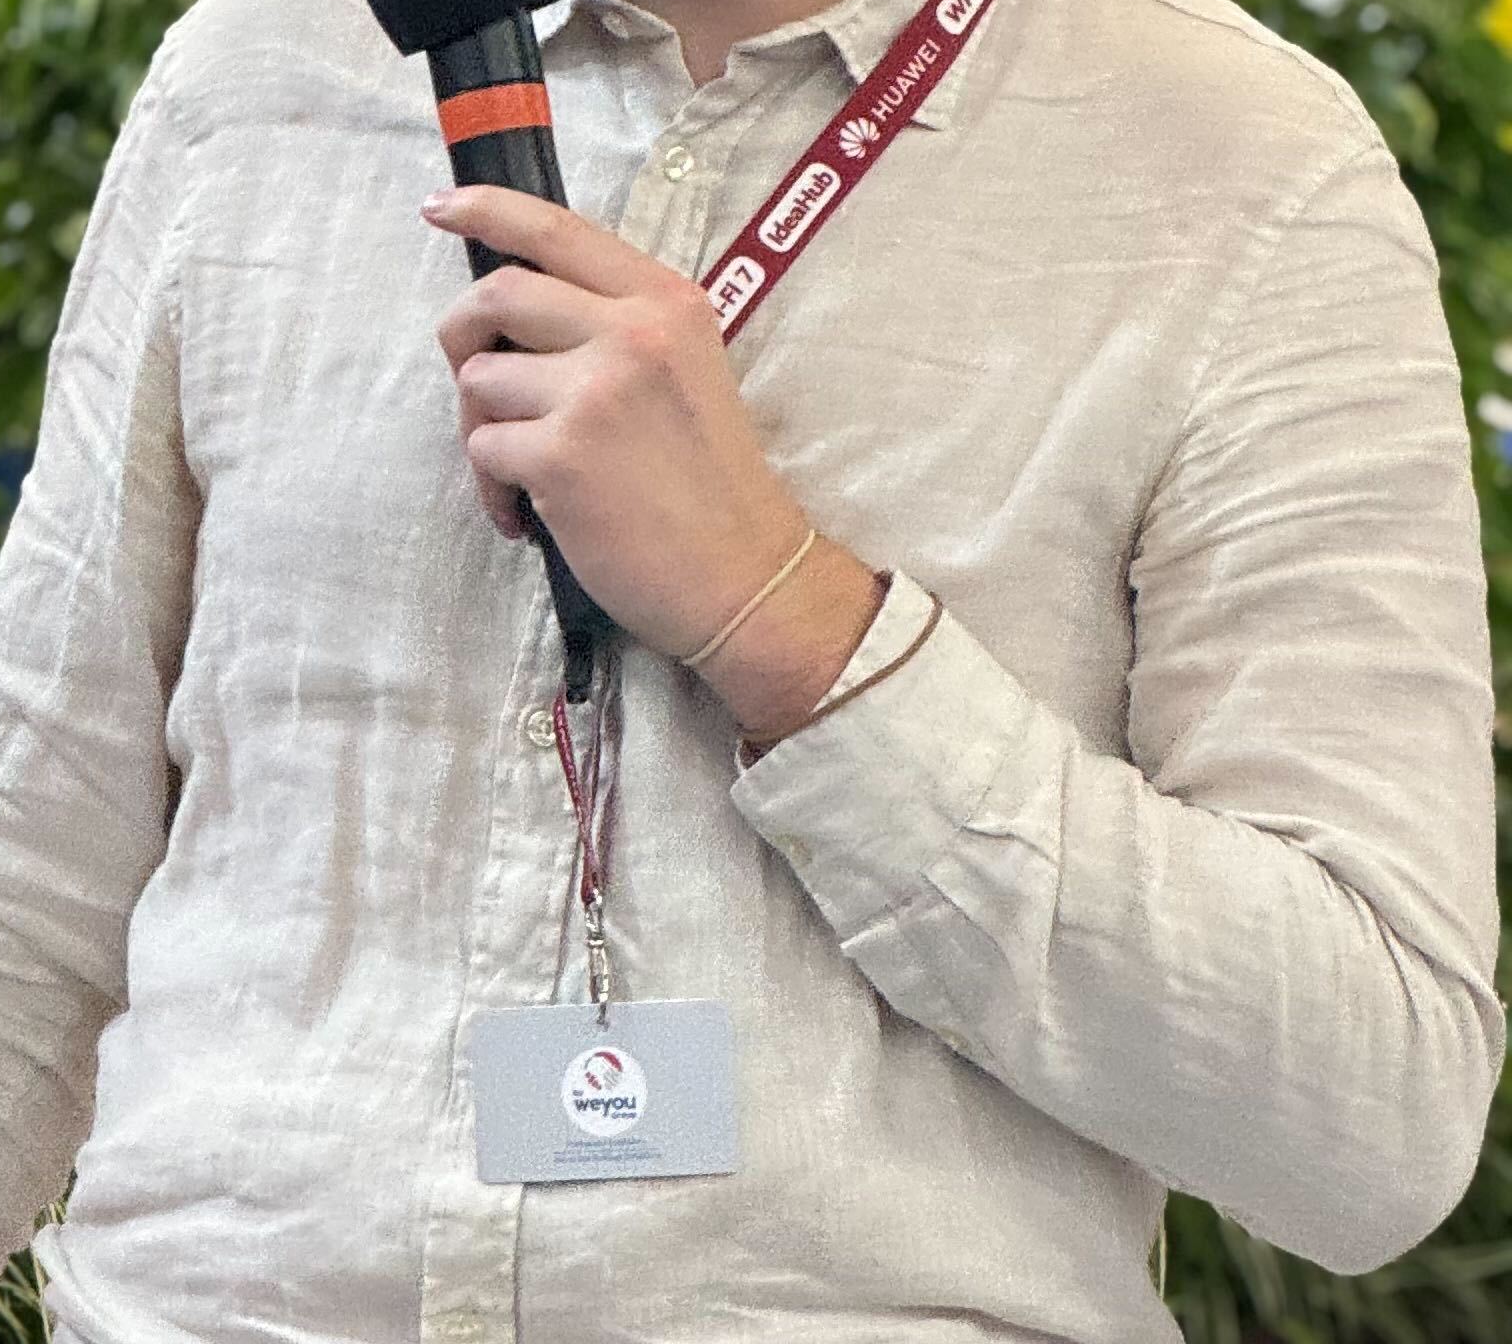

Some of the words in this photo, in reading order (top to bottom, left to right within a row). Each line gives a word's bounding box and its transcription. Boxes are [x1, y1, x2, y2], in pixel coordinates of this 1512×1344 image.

[871, 38, 941, 121] HUAWEI
[766, 171, 834, 247] IdeaHub
[735, 265, 754, 283] 7
[574, 1096, 637, 1117] weyou
